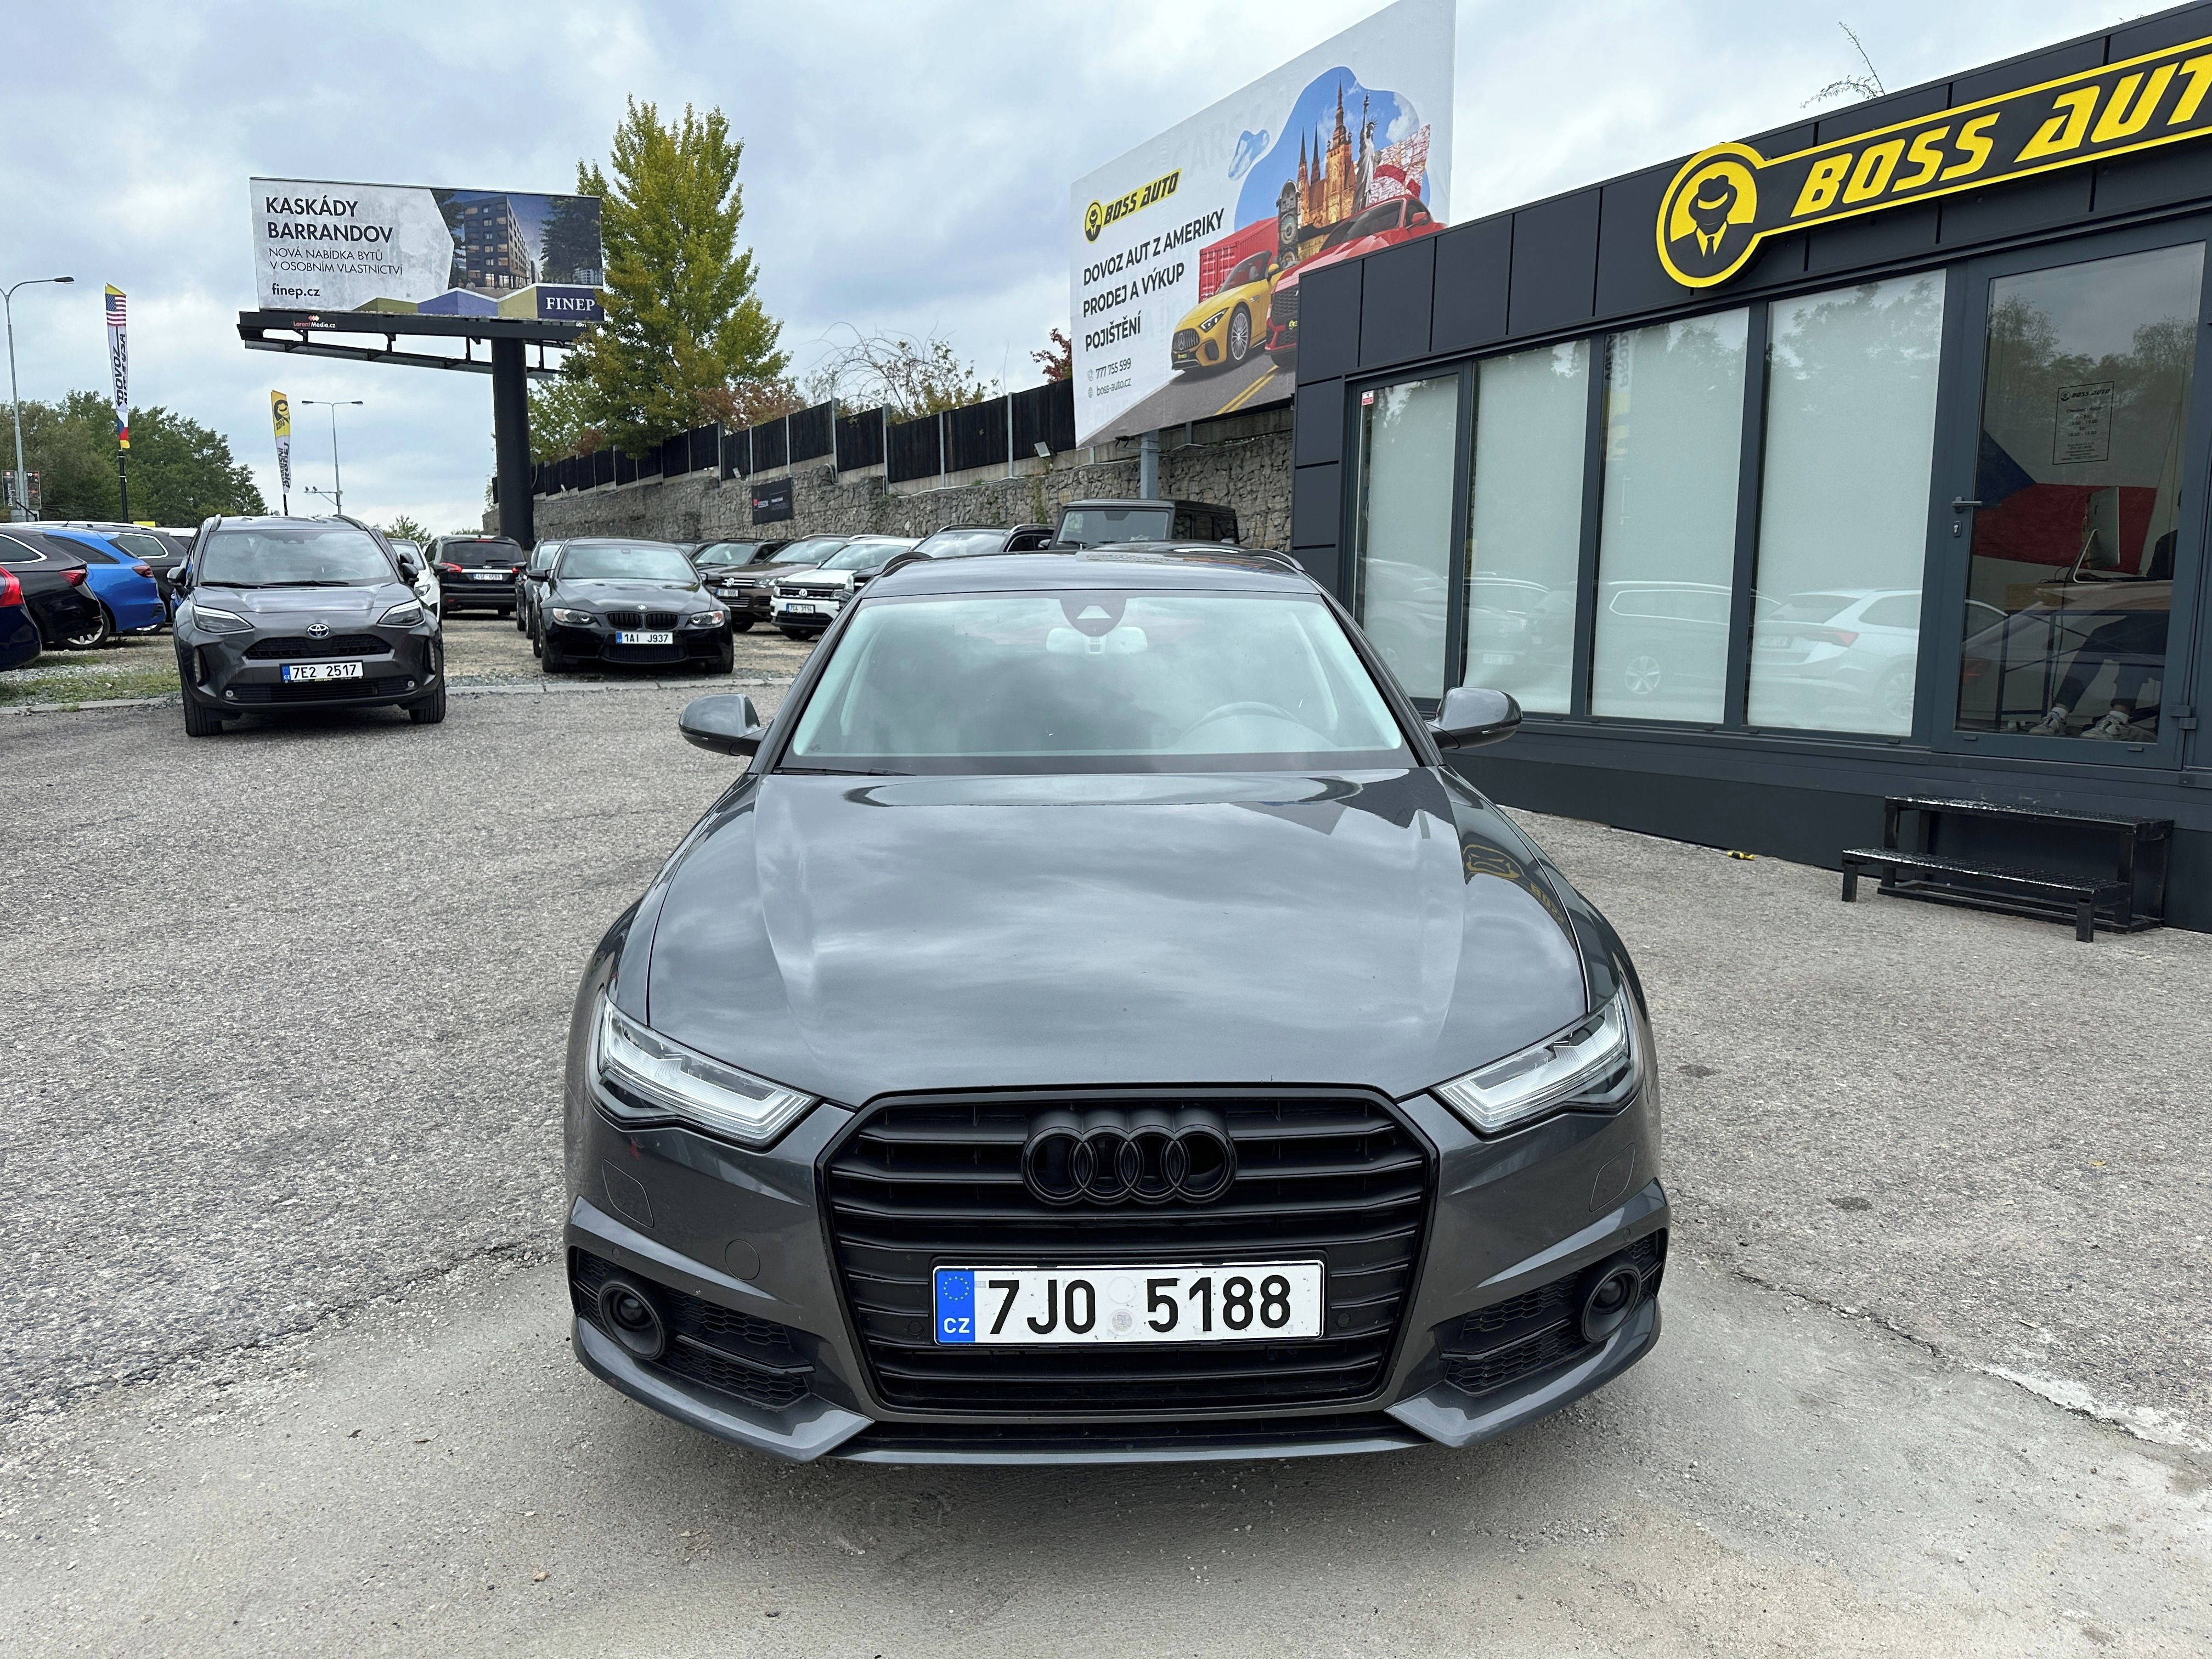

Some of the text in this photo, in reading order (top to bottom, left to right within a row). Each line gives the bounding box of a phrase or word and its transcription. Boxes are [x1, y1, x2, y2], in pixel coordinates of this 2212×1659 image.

[1790, 111, 2001, 218] BOSS
[266, 195, 358, 217] KASKÁDY
[1103, 171, 1180, 225] BOSS AUTO
[268, 222, 393, 243] BARRANDOV
[269, 246, 383, 261] NOVÁ NABÍDKA BYTŮ
[1084, 207, 1224, 286] DOVOZ AUT Z AMERIKY
[270, 261, 403, 275] V OSOBNÍM VLASTNICTVÍ
[272, 283, 320, 299] finep.cz
[1083, 262, 1184, 318] PRODEJ A VÝKUP
[546, 297, 595, 311] FINEP
[1085, 310, 1142, 352] POJIŠTĚNÍ
[112, 345, 124, 401] DOVOZ
[1096, 358, 1131, 379] 777 755 599
[1096, 378, 1131, 396] boss-auto.cz
[647, 634, 668, 642] J937
[292, 667, 317, 679] 7E2
[326, 664, 357, 677] 2517
[943, 1274, 1291, 1335] CZ 7J0 5188
